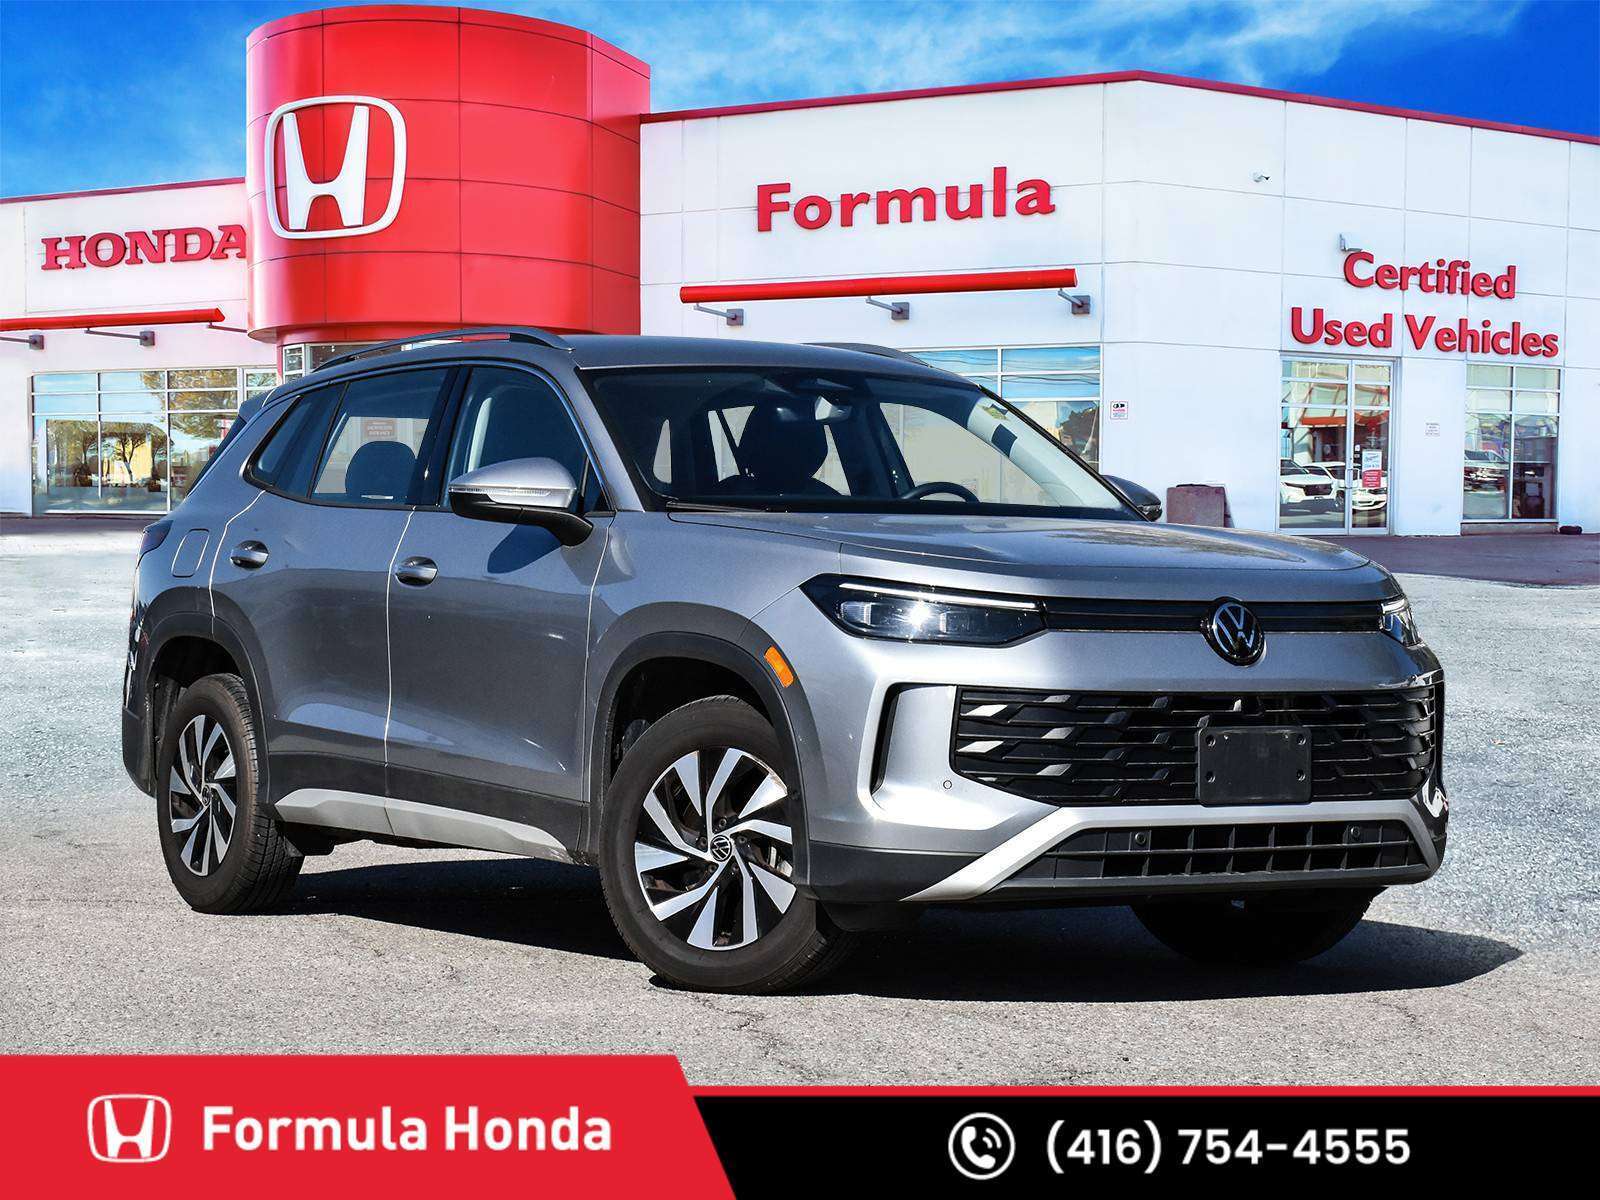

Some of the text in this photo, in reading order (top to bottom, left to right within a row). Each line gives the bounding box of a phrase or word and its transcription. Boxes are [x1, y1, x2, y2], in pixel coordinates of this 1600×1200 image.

[757, 166, 1056, 232] Formula
[41, 224, 247, 270] HONDA
[1343, 251, 1517, 299] Certified
[1291, 306, 1559, 357] Used Vehicles
